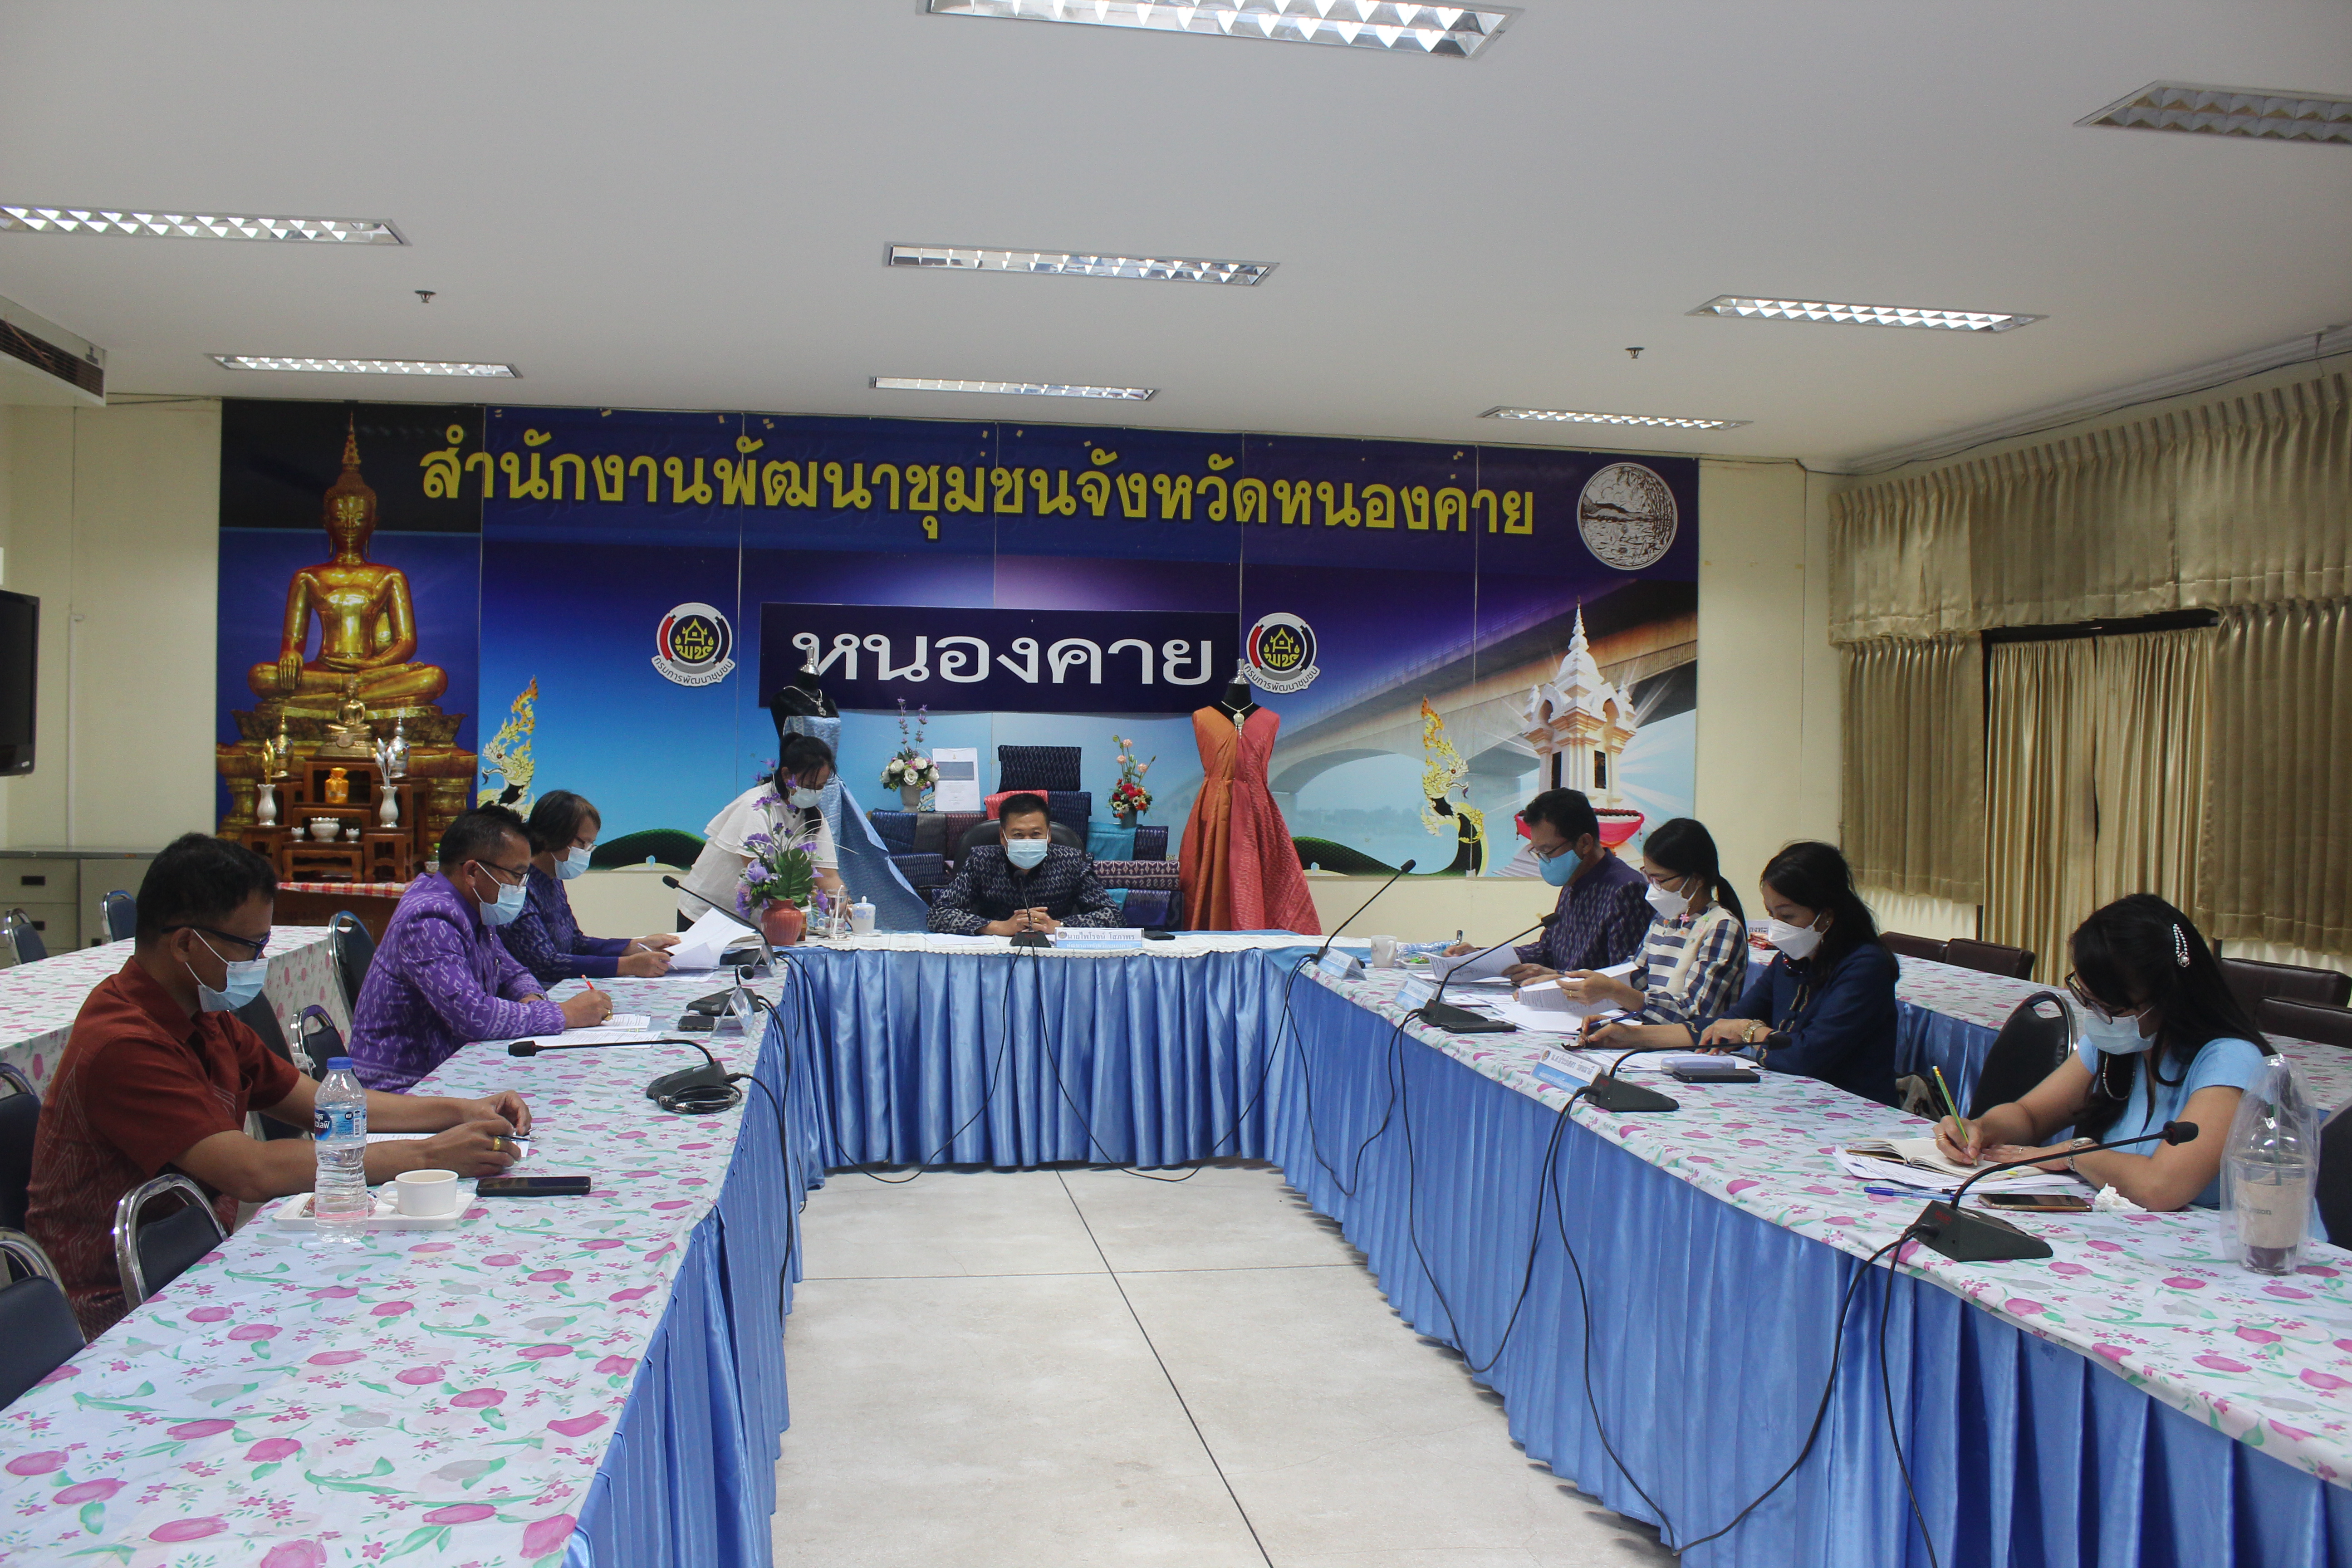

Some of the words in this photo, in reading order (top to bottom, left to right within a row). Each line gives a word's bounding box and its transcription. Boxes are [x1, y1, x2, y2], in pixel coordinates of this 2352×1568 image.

[420, 424, 1533, 539] สำนักงานพัฒนาชุมชนจังหวัดหนองคาย
[653, 657, 733, 684] กรมการพัฒนาชุมชน
[792, 632, 1212, 685] หนองคาย
[1245, 666, 1318, 691] กรมการพัฒนาชุมชน
[1067, 931, 1106, 940] นายไพโรจน์
[1109, 932, 1135, 940] โสภาพร
